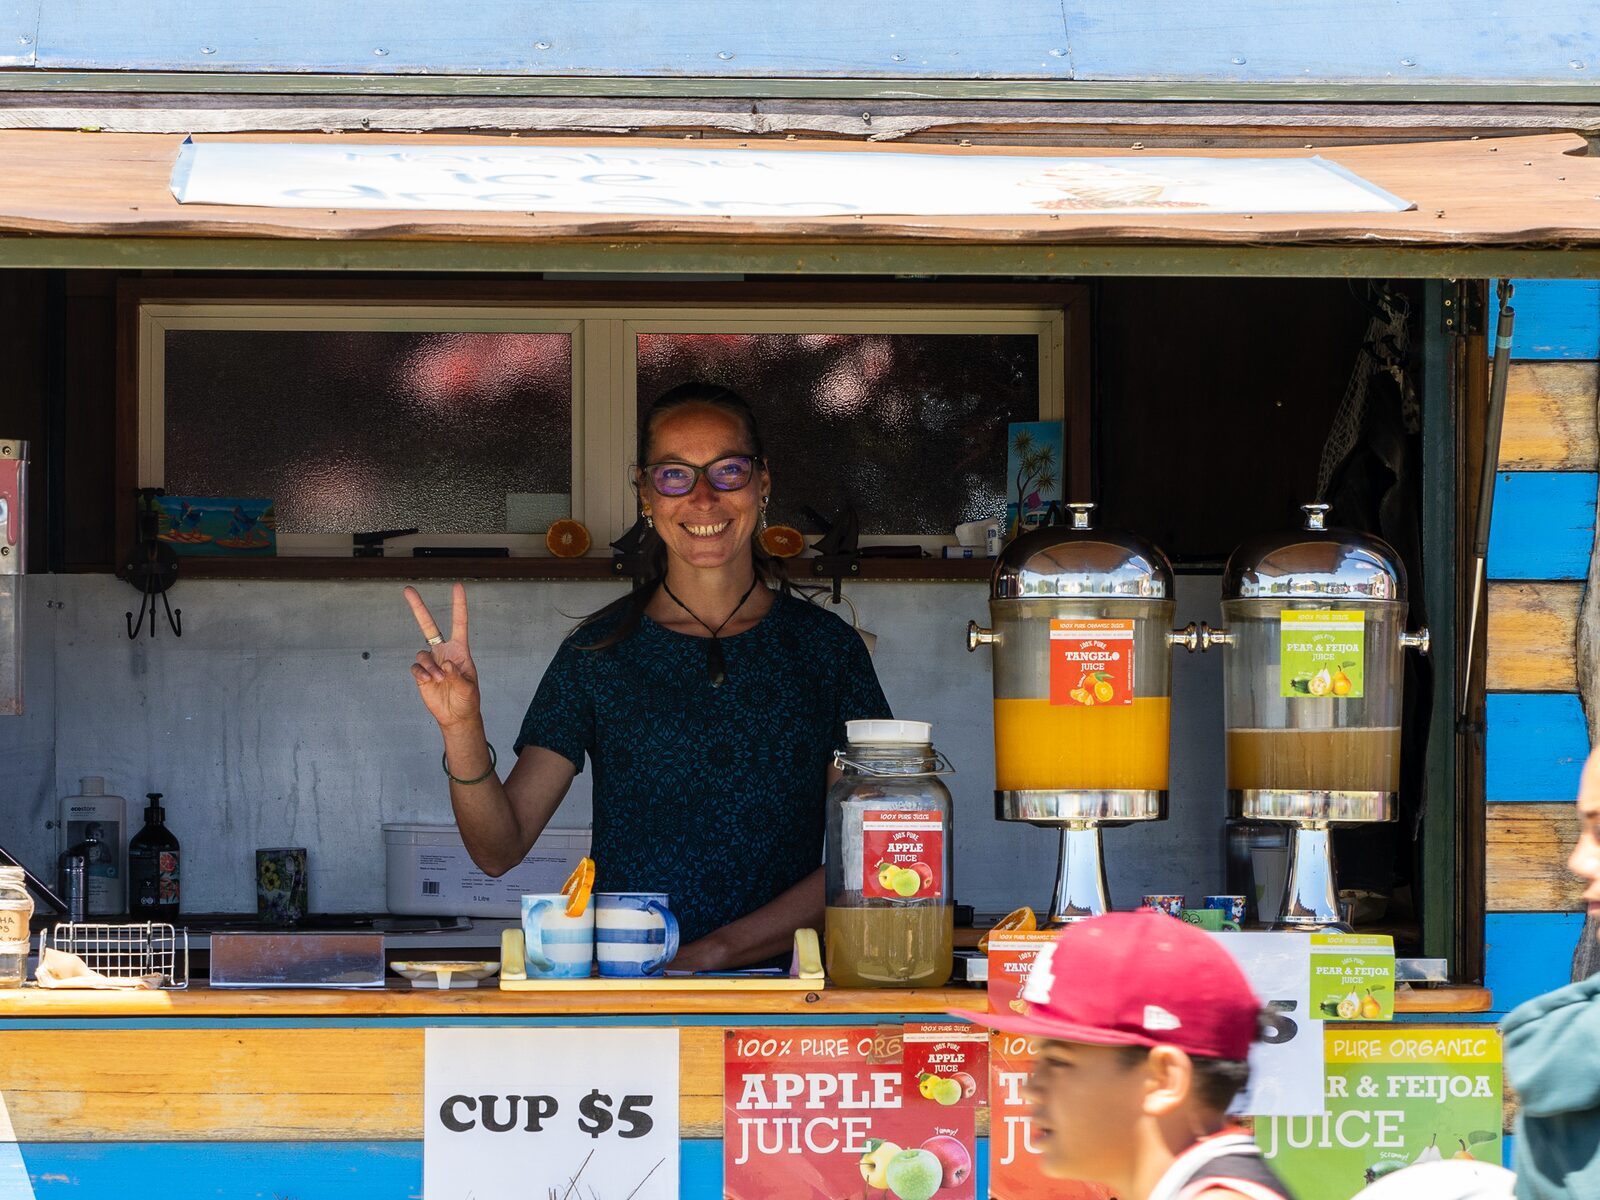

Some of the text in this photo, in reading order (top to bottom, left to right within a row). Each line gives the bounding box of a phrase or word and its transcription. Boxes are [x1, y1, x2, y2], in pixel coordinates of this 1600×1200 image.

[1286, 643, 1360, 654] PEAR & FEIJOA
[1064, 651, 1120, 661] TANGELO
[1311, 653, 1335, 662] JUICE
[1080, 662, 1105, 672] JUICE
[886, 843, 924, 853] APPLE
[893, 854, 918, 864] JUICE
[1316, 966, 1389, 977] PEAR & FEIJOA
[1341, 976, 1364, 985] JUICE
[737, 1038, 794, 1057] 100%
[801, 1038, 849, 1056] PURE
[1334, 1038, 1487, 1058] PURE ORGANIC
[927, 1053, 965, 1063] APPLE
[934, 1064, 959, 1074] JUICE
[736, 1072, 902, 1110] APPLE
[1356, 1075, 1380, 1098] &
[1386, 1075, 1493, 1104] FEIJOA
[439, 1088, 654, 1139] CUP $5
[1263, 1110, 1405, 1159] JUICE
[735, 1116, 872, 1165] JUICE
